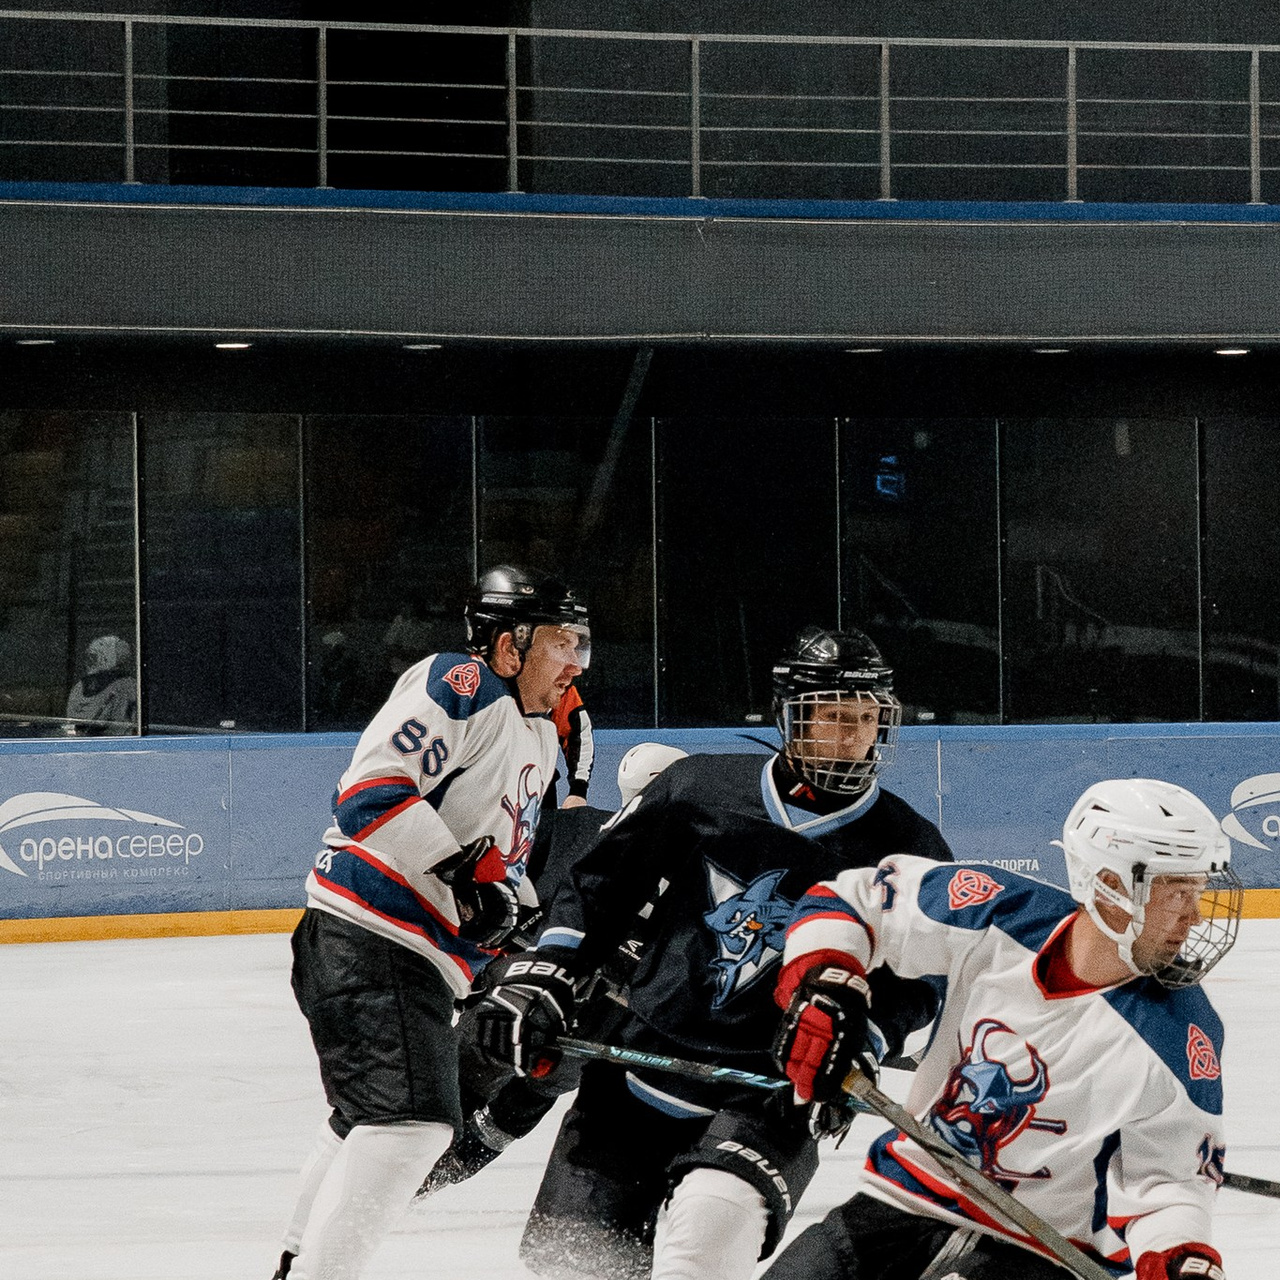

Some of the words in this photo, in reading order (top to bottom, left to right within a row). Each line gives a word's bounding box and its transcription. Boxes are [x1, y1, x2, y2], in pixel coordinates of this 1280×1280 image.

[390, 717, 449, 777] 88
[123, 866, 189, 878] КОМПЛЕКС
[716, 1140, 791, 1214] BAUER
